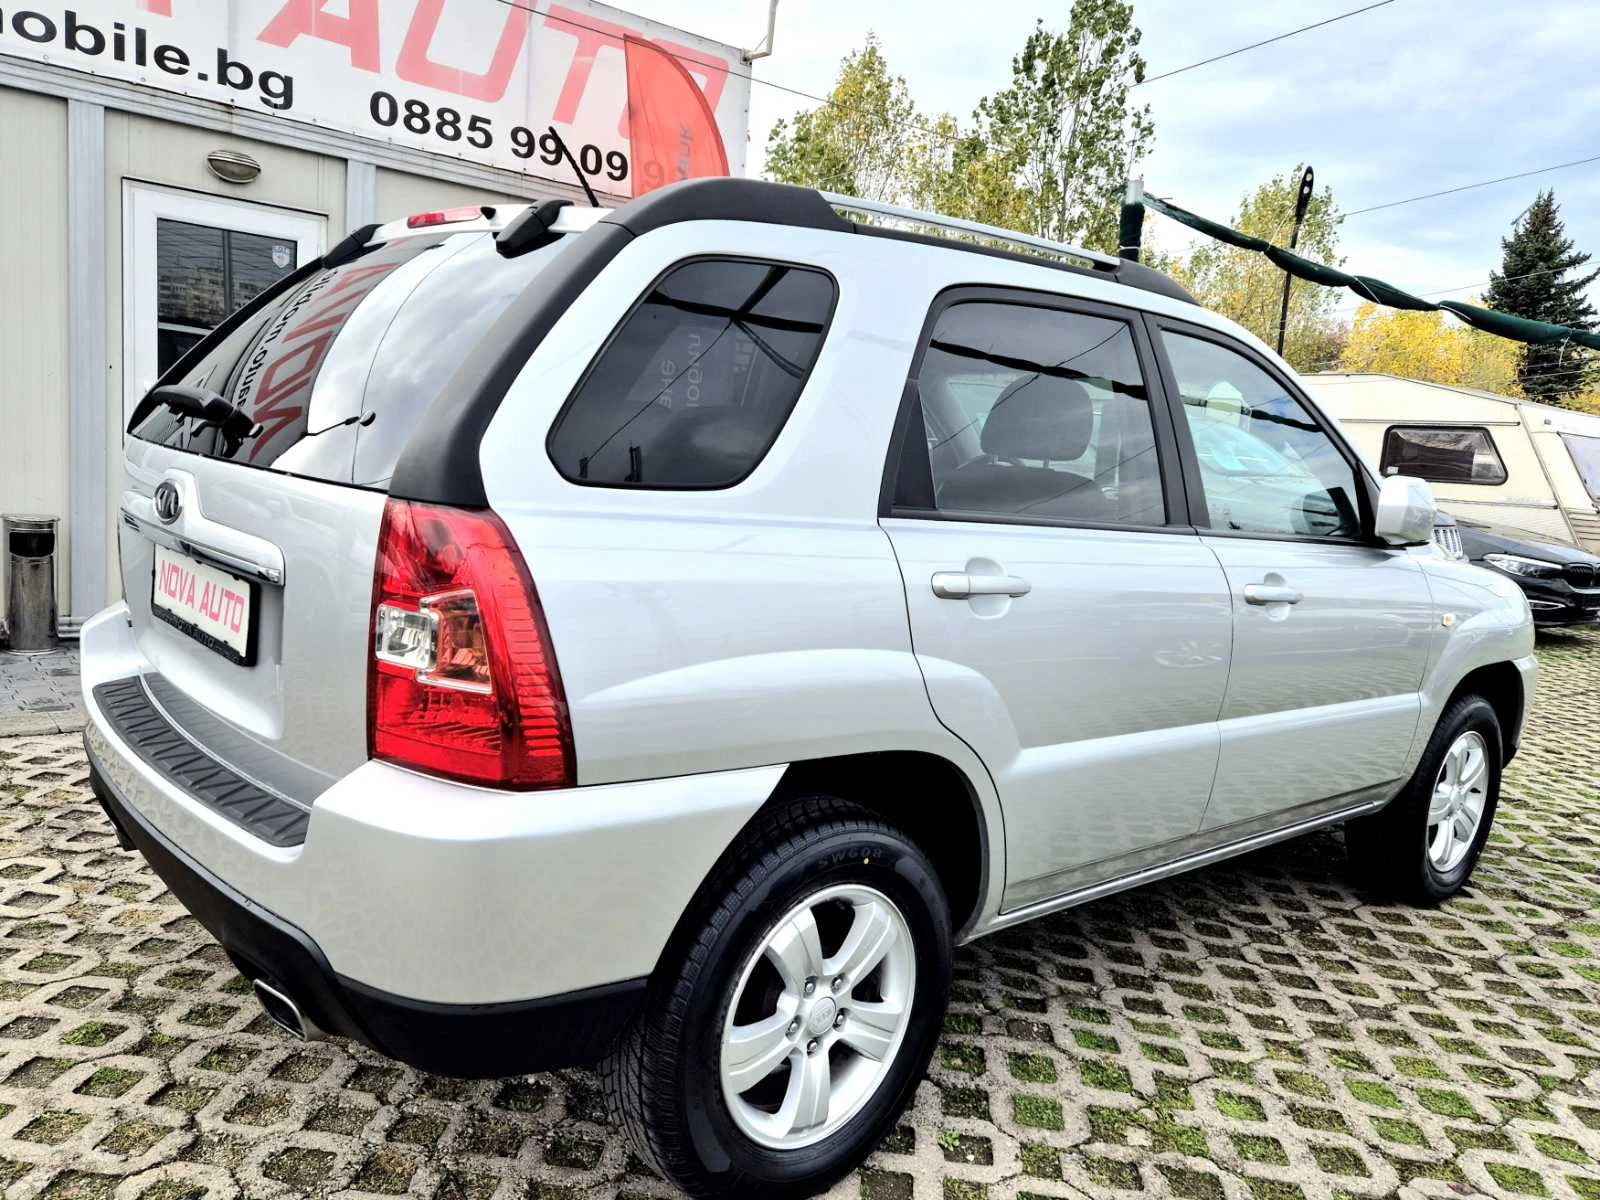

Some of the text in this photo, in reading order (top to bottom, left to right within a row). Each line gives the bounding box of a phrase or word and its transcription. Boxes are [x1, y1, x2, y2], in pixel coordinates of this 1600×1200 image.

[0, 8, 294, 111] obile.bg
[370, 90, 494, 149] 0885
[510, 126, 564, 167] 99
[580, 144, 628, 181] 09
[159, 560, 195, 608] NOVA
[199, 580, 245, 633] AUTO
